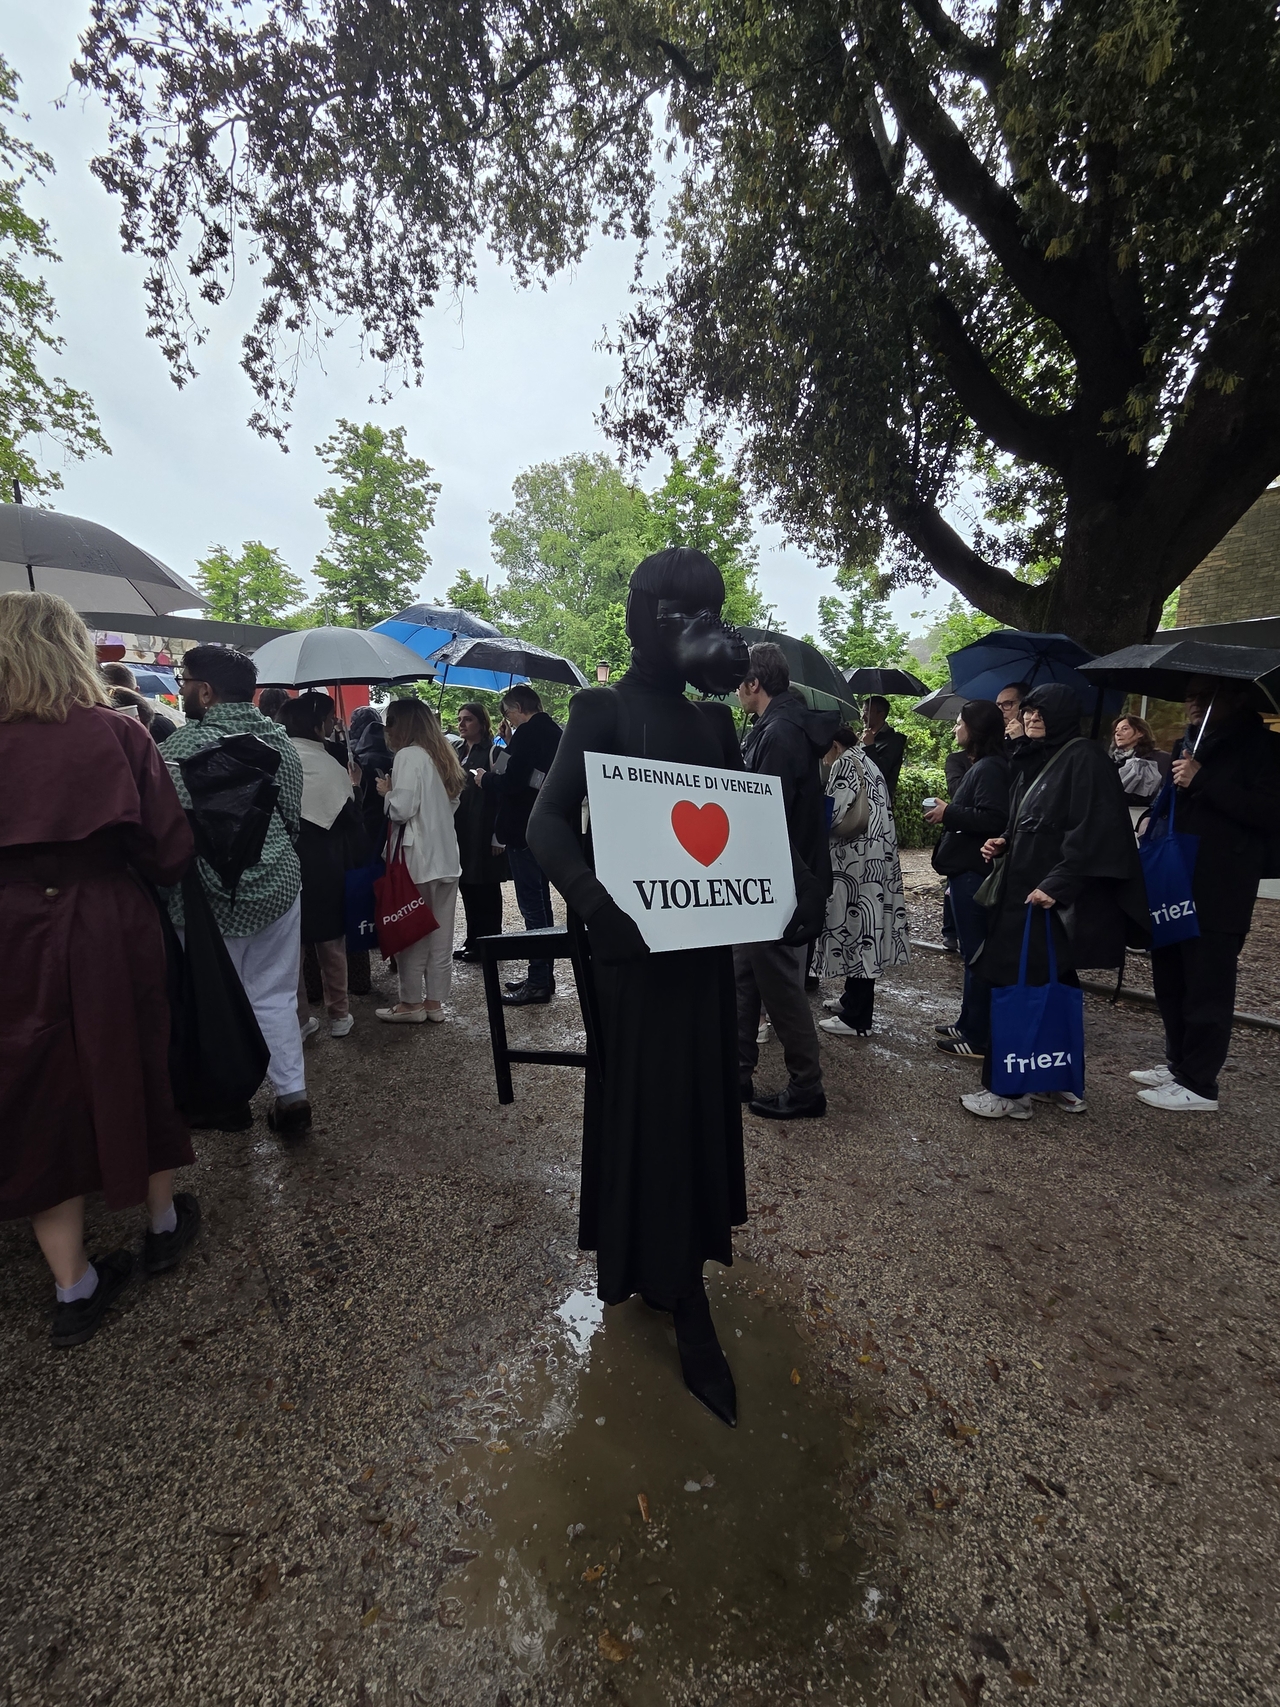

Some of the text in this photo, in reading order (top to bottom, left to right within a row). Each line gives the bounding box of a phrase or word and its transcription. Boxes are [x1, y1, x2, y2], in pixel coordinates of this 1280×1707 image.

[602, 764, 773, 796] LA BIENNALE DI VENEZIA
[632, 878, 775, 911] VIOLENCE
[1149, 900, 1197, 925] riez
